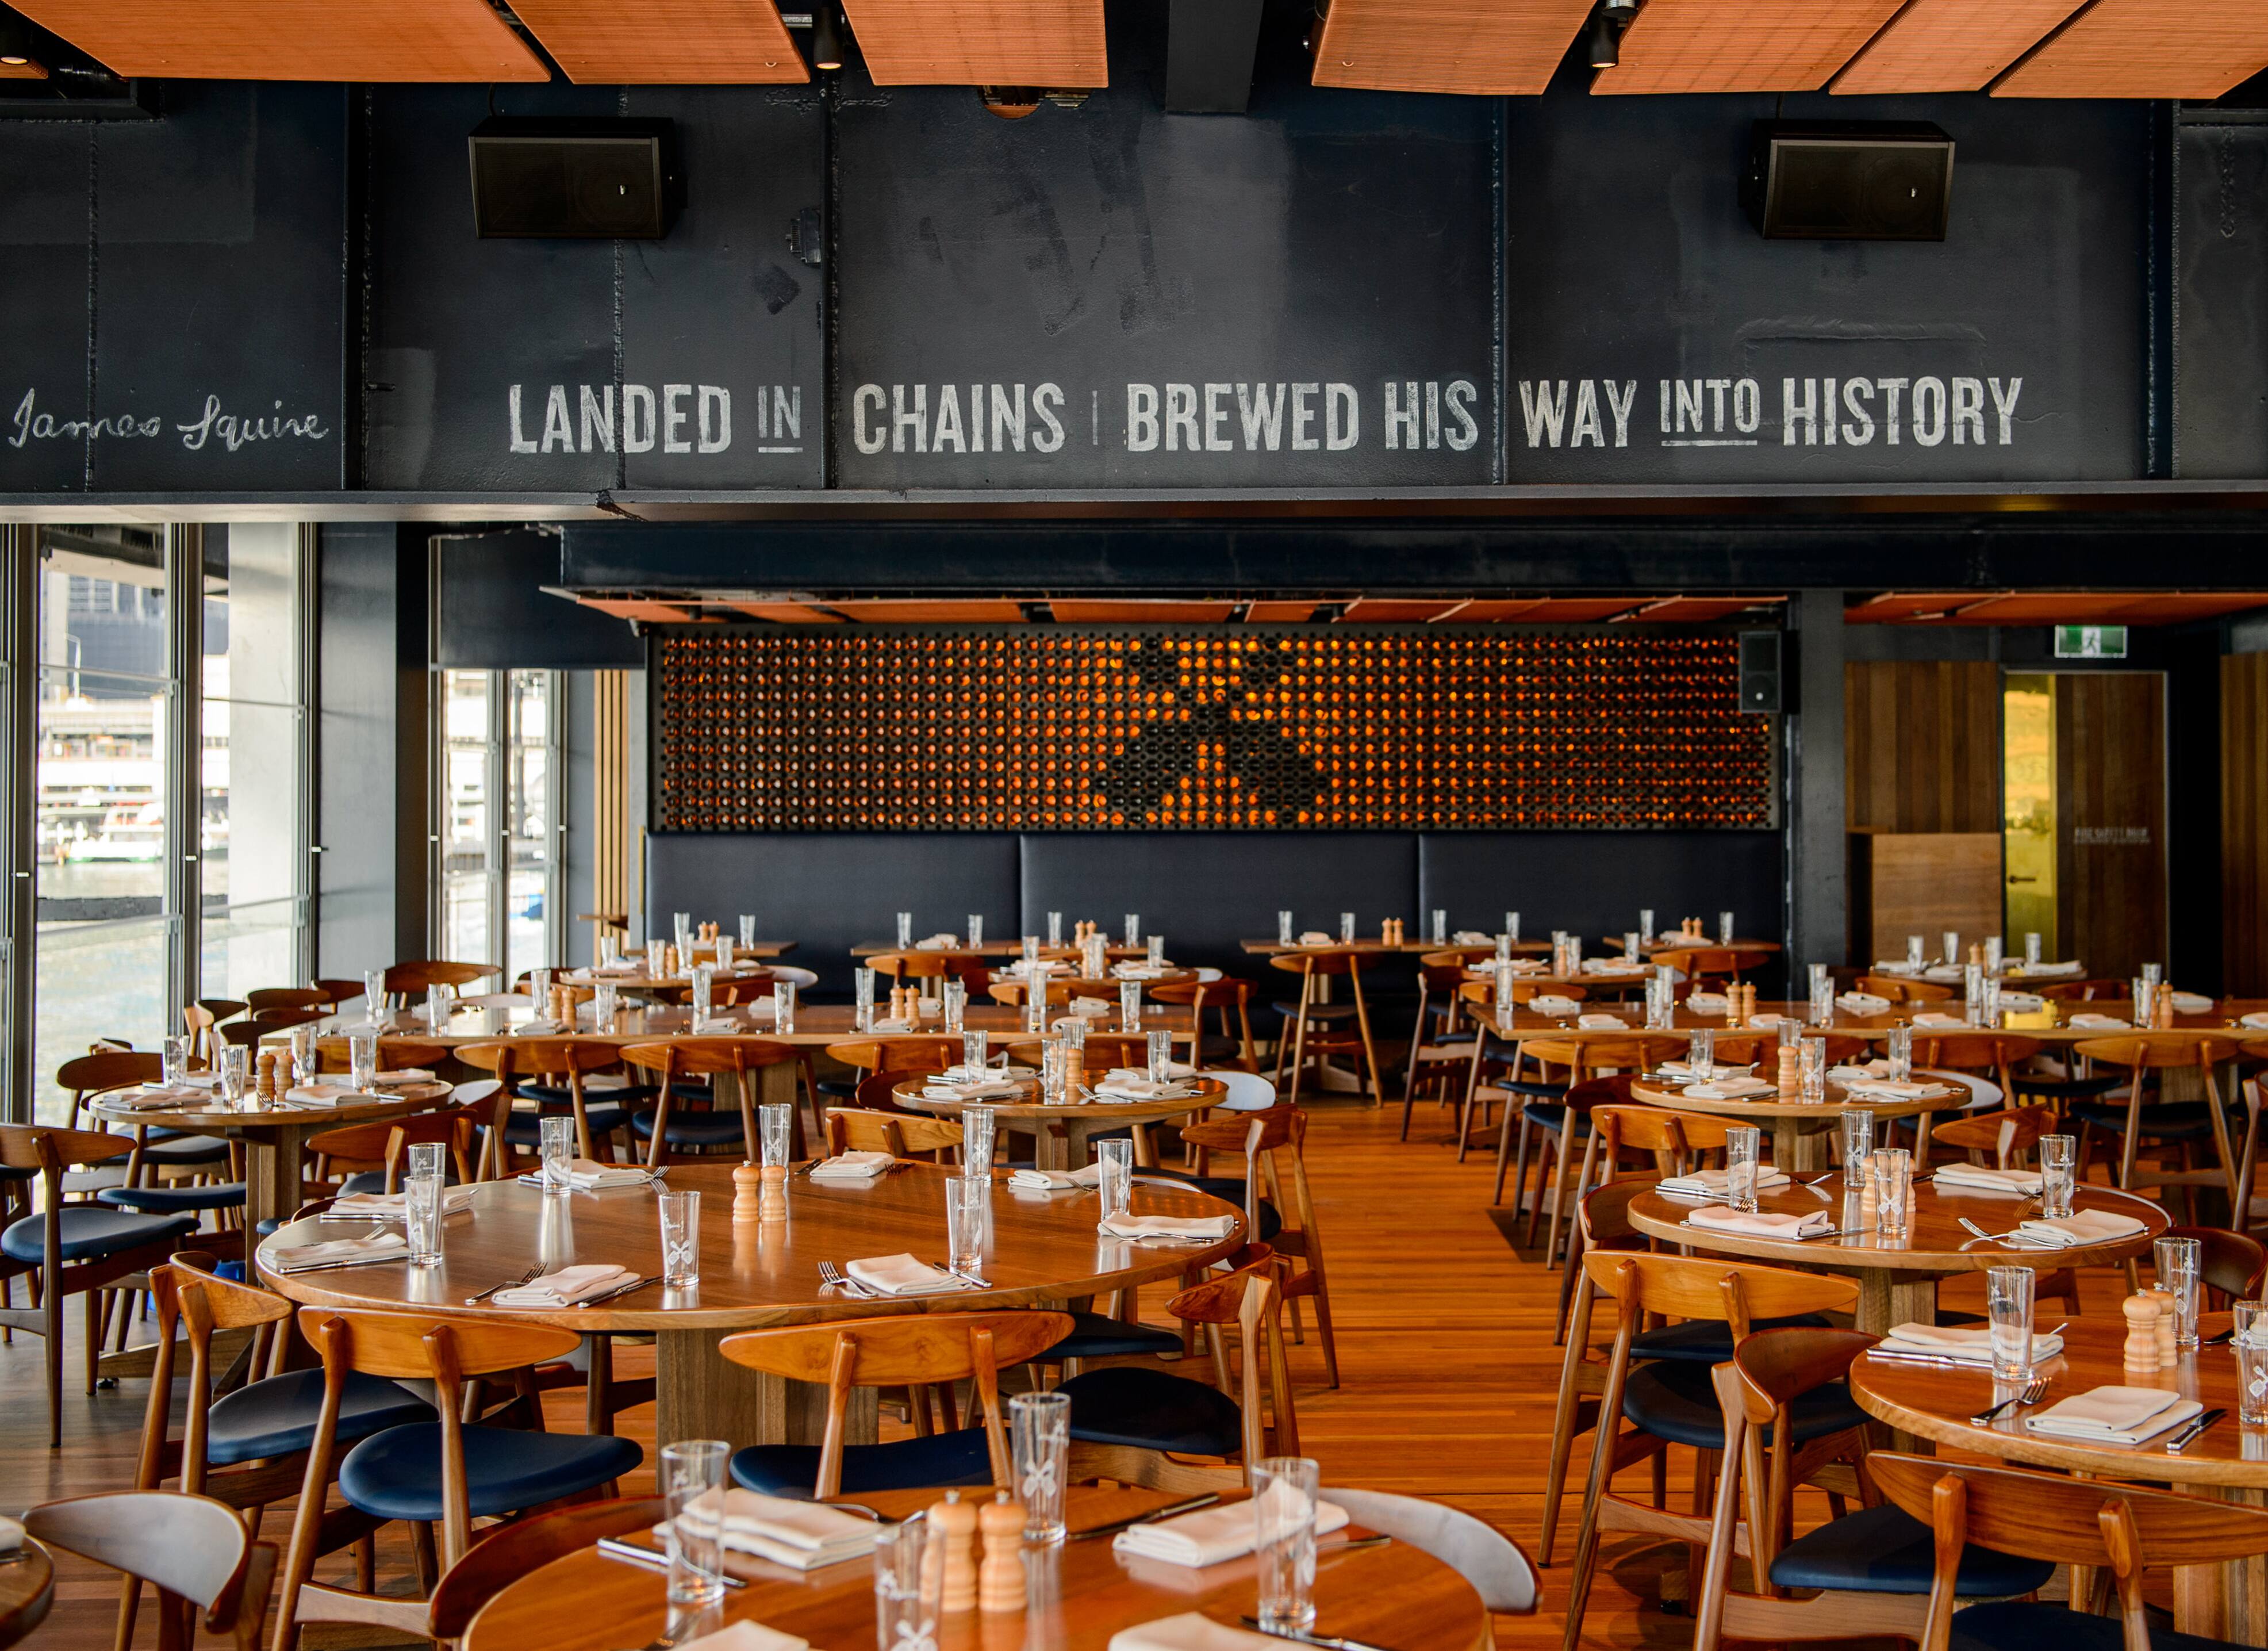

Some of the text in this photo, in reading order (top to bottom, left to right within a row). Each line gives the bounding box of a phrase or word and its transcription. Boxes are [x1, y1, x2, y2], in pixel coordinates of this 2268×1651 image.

[9, 388, 328, 451] James Squire
[509, 376, 2023, 454] LANDED IN CHAINS BREWED HIS WAY INTO HISTORY
